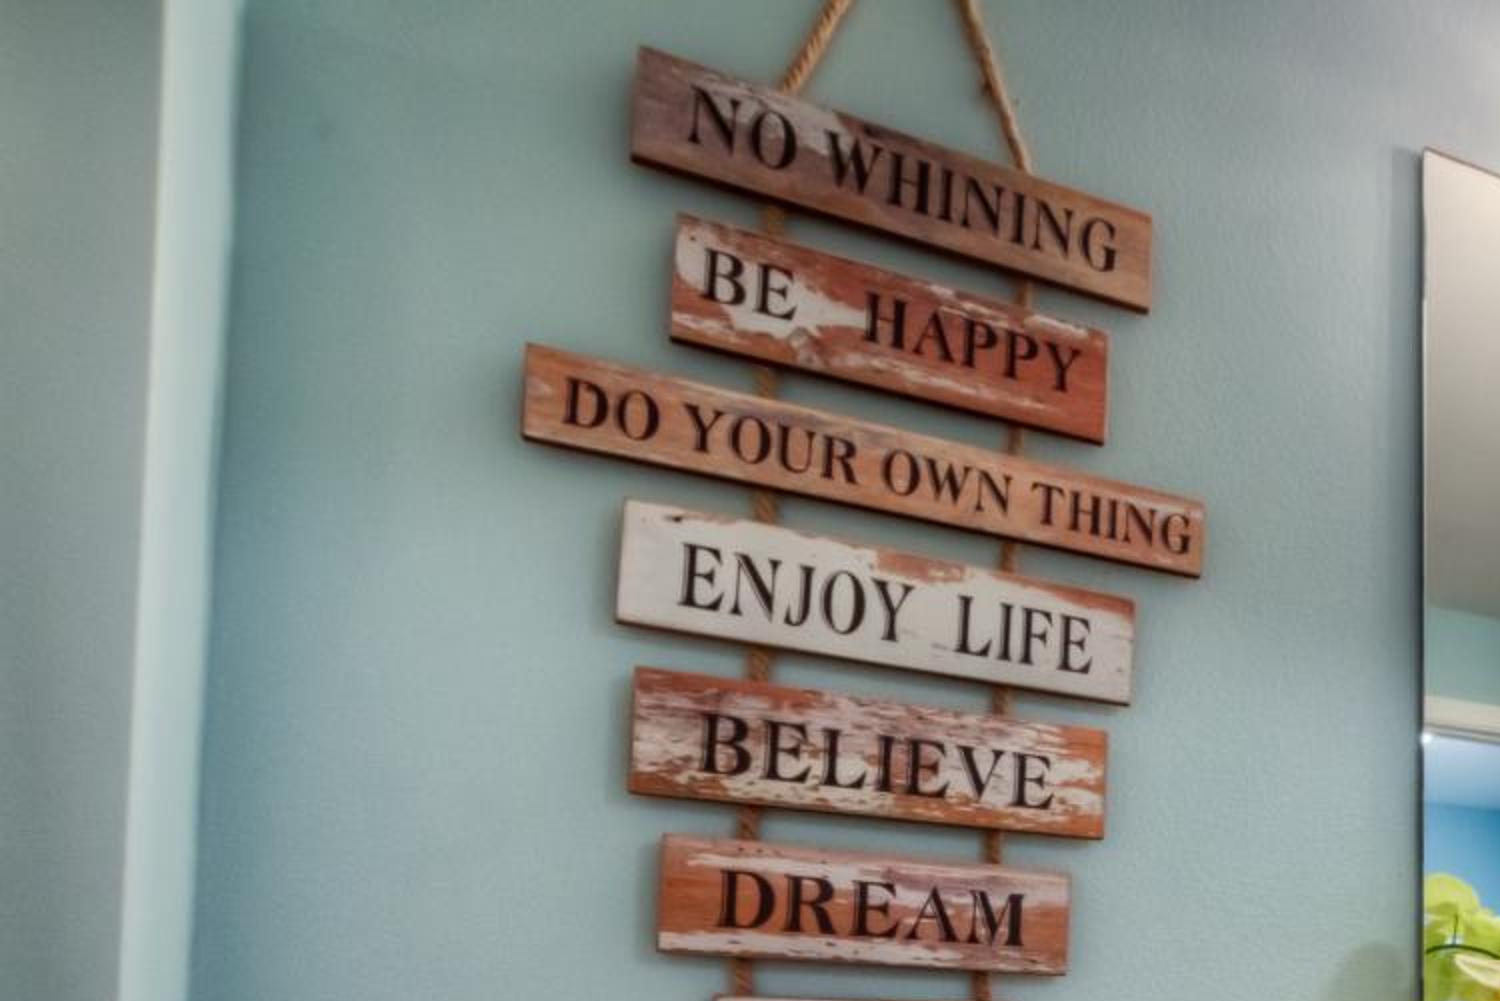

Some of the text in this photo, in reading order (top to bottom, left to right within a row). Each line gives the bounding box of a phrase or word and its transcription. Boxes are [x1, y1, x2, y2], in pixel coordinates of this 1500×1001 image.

[691, 89, 1117, 273] NO WHINING
[704, 249, 1081, 392] BE HAPPY
[563, 379, 1191, 554] DO YOUR OWN THING
[679, 544, 1094, 674] ENJOY LIFE
[701, 713, 1053, 809] BELIEVE
[717, 871, 1024, 946] DREAM
